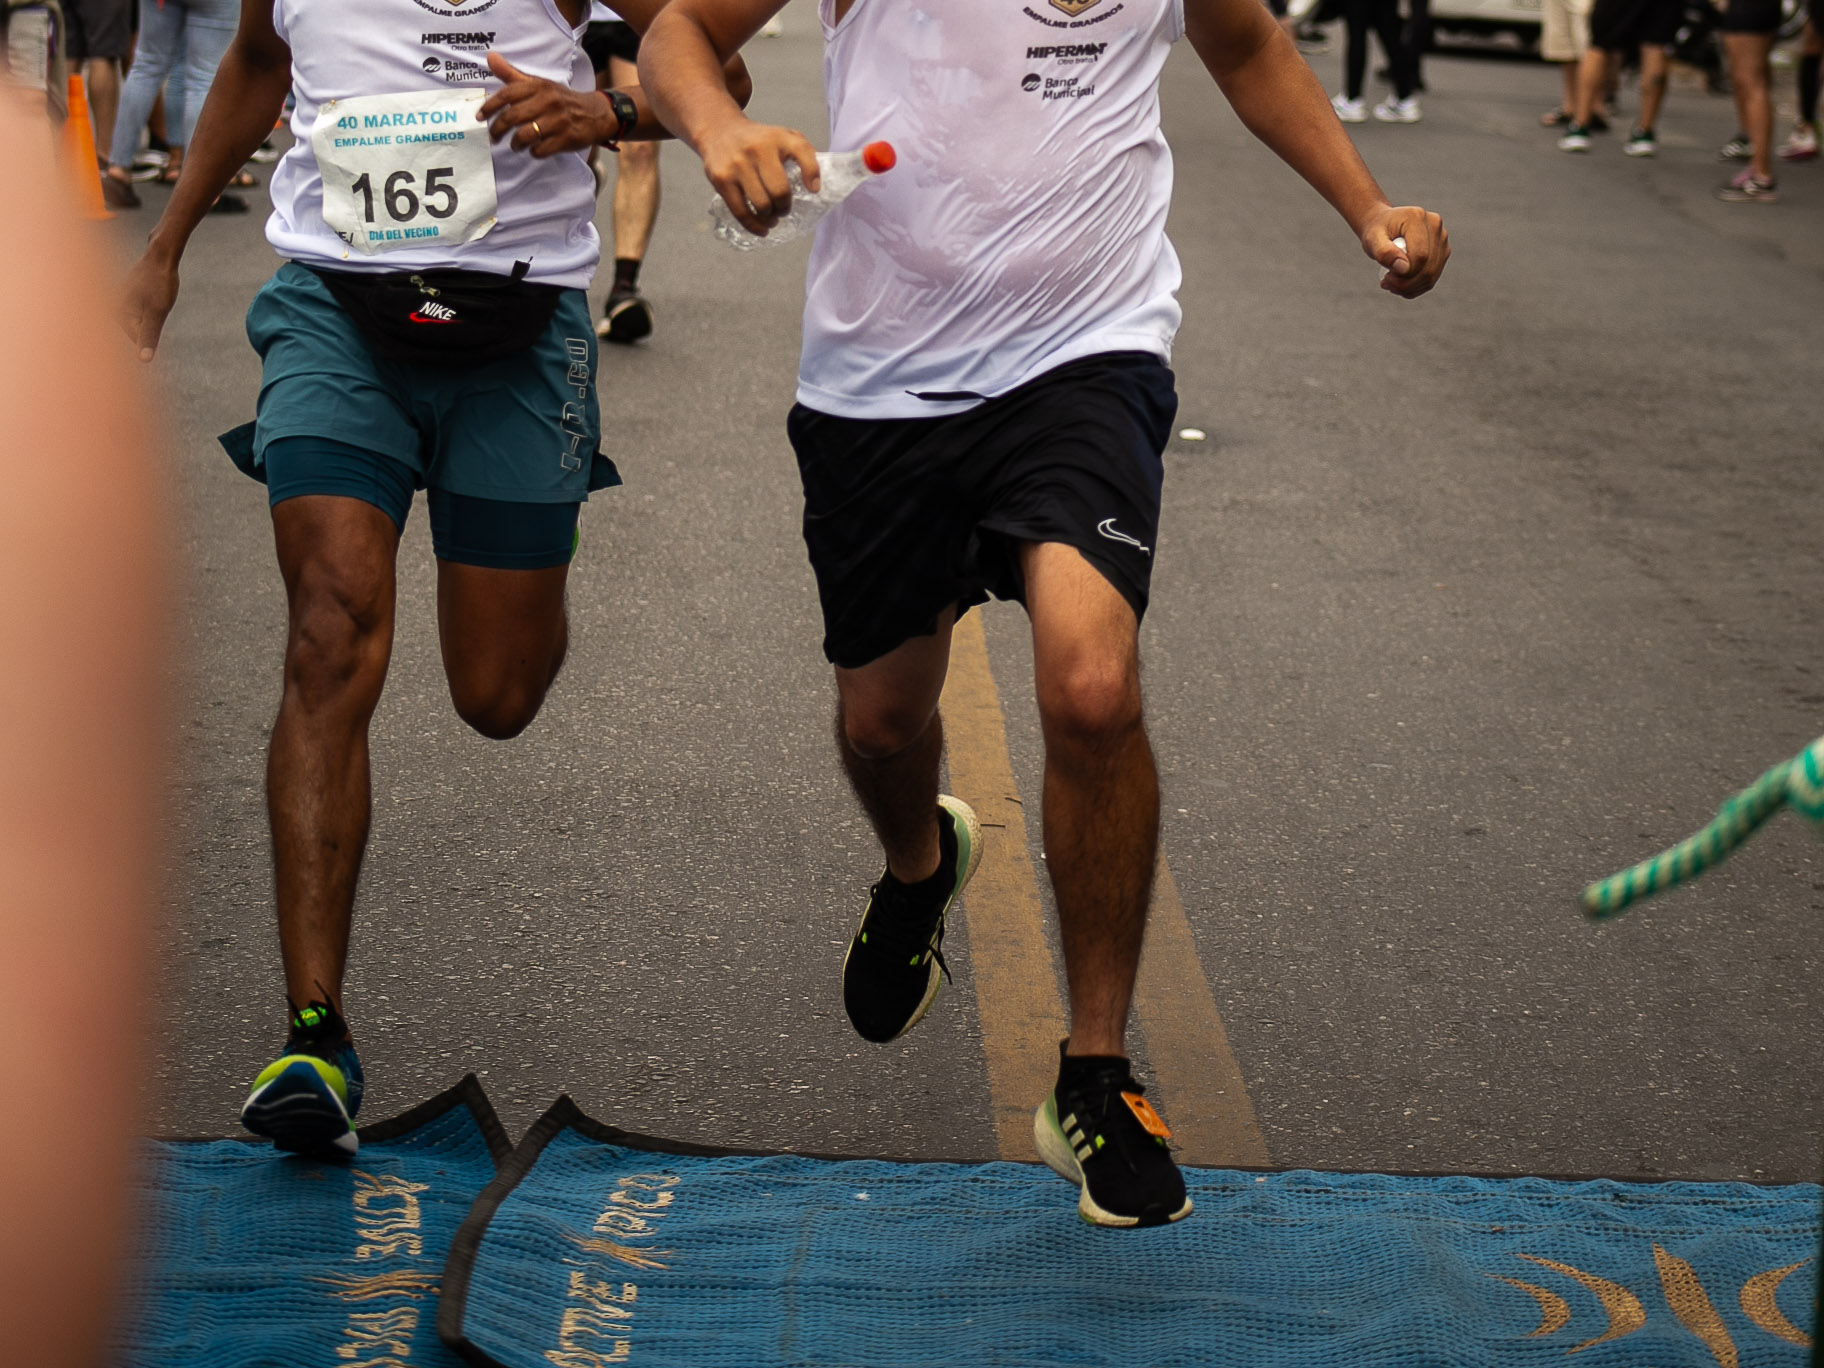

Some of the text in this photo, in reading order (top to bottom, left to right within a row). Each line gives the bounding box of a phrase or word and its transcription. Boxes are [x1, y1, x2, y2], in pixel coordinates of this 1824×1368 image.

[1022, 3, 1124, 28] EMPALME GRANEROS
[445, 60, 478, 71] Banco
[446, 69, 494, 81] Municipa
[1045, 78, 1078, 88] Banco
[1042, 85, 1095, 100] Municipal
[337, 111, 458, 130] 40 MARATON
[335, 131, 465, 148] EMPALME GRANEROS
[352, 167, 459, 223] 165
[386, 229, 403, 240] DEL
[404, 226, 439, 239] VECINO
[419, 302, 457, 320] NIKE
